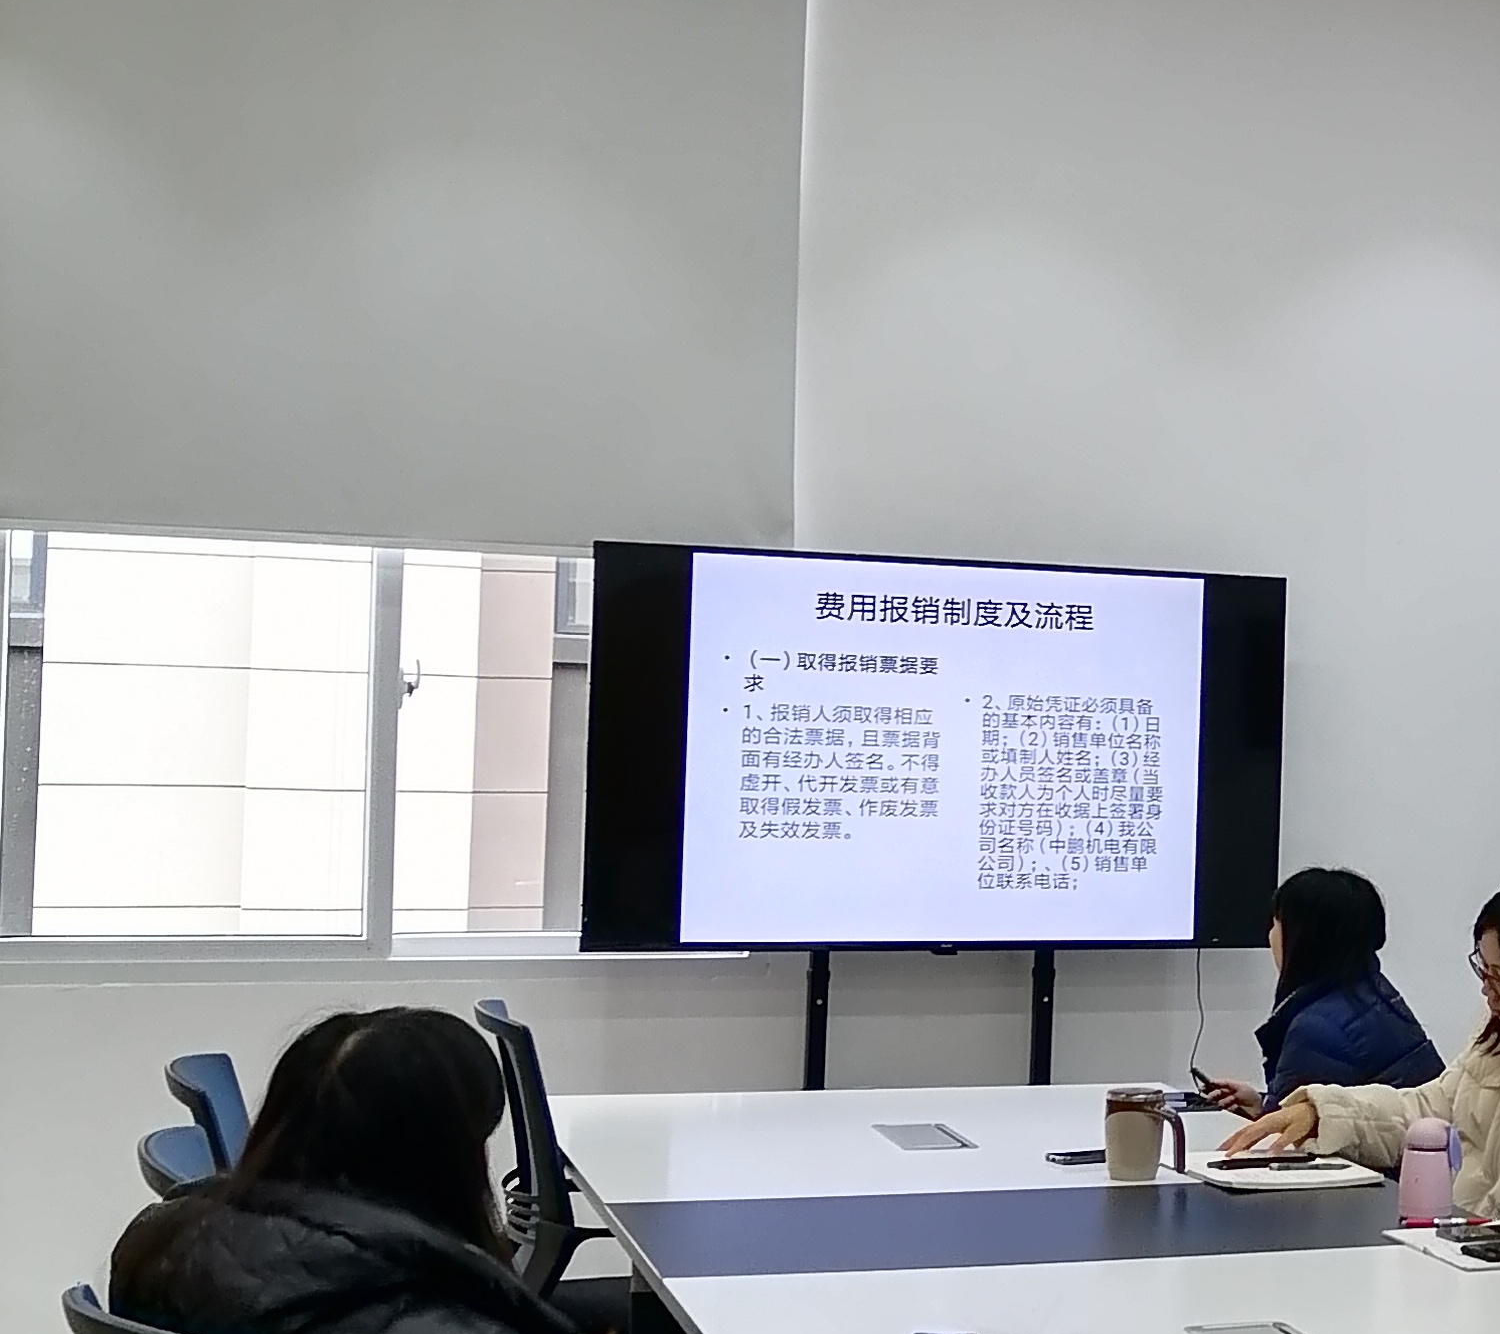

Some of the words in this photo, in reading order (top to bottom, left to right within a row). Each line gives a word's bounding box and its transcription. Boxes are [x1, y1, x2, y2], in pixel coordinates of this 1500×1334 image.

[815, 591, 1095, 633] 费用报销制度及流程
[750, 650, 938, 675] （一）取得报销票据要
[743, 676, 764, 692] 求
[743, 704, 933, 725] 1、报销人须取得相应
[982, 695, 1153, 715] 2、原始凭证必须具备
[742, 727, 940, 749] 的合法票据，且票据背
[741, 751, 940, 771] 面有经办人签名。不得
[740, 773, 939, 794] 虚开、代开发票或有意
[980, 785, 1163, 802] 收款人为个人时尽量要
[739, 797, 938, 817] 取得假发票、作废发票
[979, 803, 1162, 819] 求对方在收据上签署身
[739, 821, 851, 840] 及失效发票。
